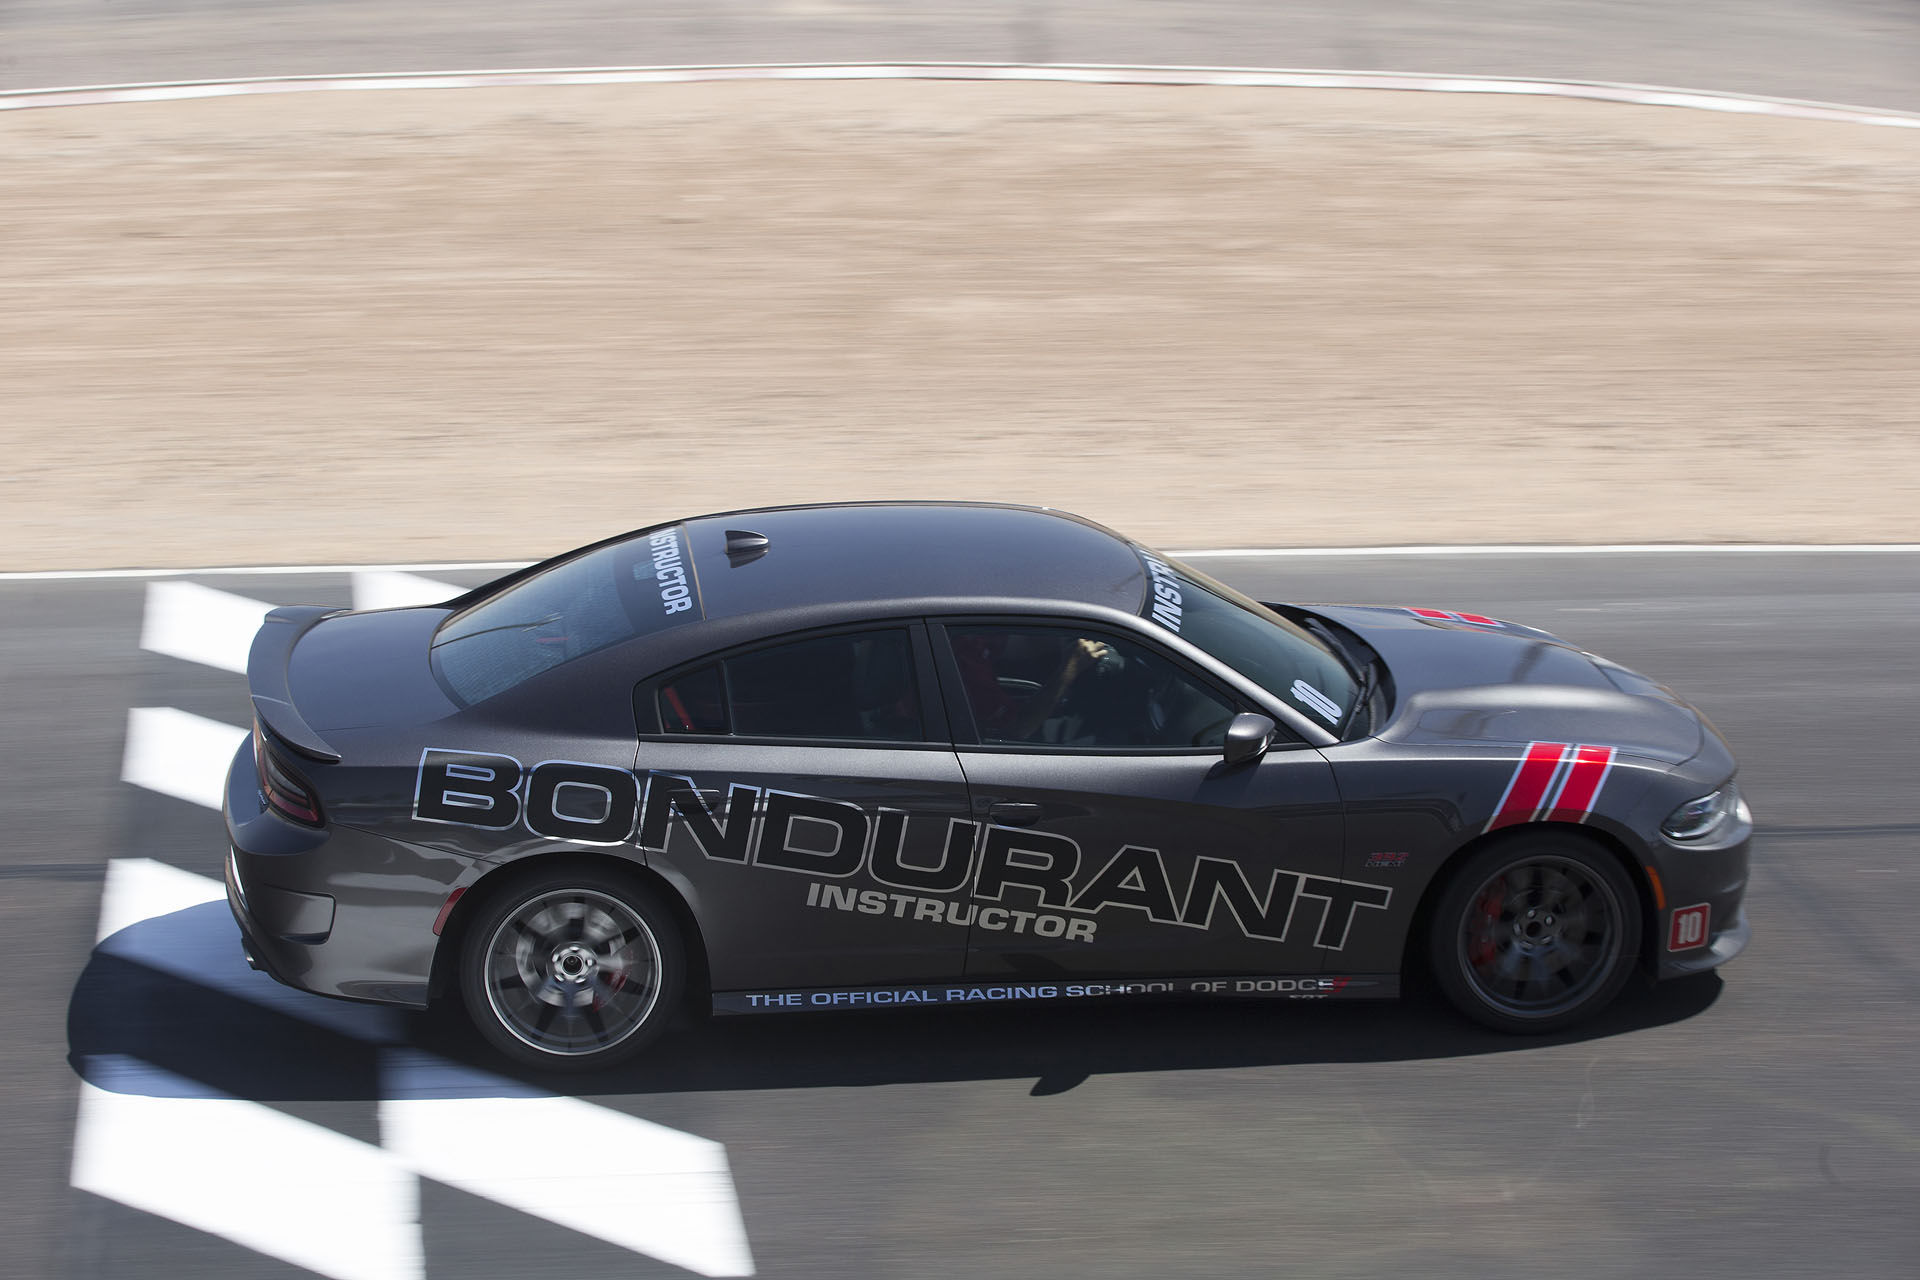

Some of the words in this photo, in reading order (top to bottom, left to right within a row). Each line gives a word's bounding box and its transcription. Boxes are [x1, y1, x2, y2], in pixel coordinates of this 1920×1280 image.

[1290, 679, 1342, 725] 10
[412, 747, 1393, 951] BONDURANT
[806, 882, 1098, 943] INSTRUCTOR
[1678, 912, 1702, 944] 10
[746, 993, 802, 1006] THE
[811, 990, 938, 1005] OFFICIAL
[946, 986, 1057, 1000] RACING
[1190, 982, 1228, 992] OF
